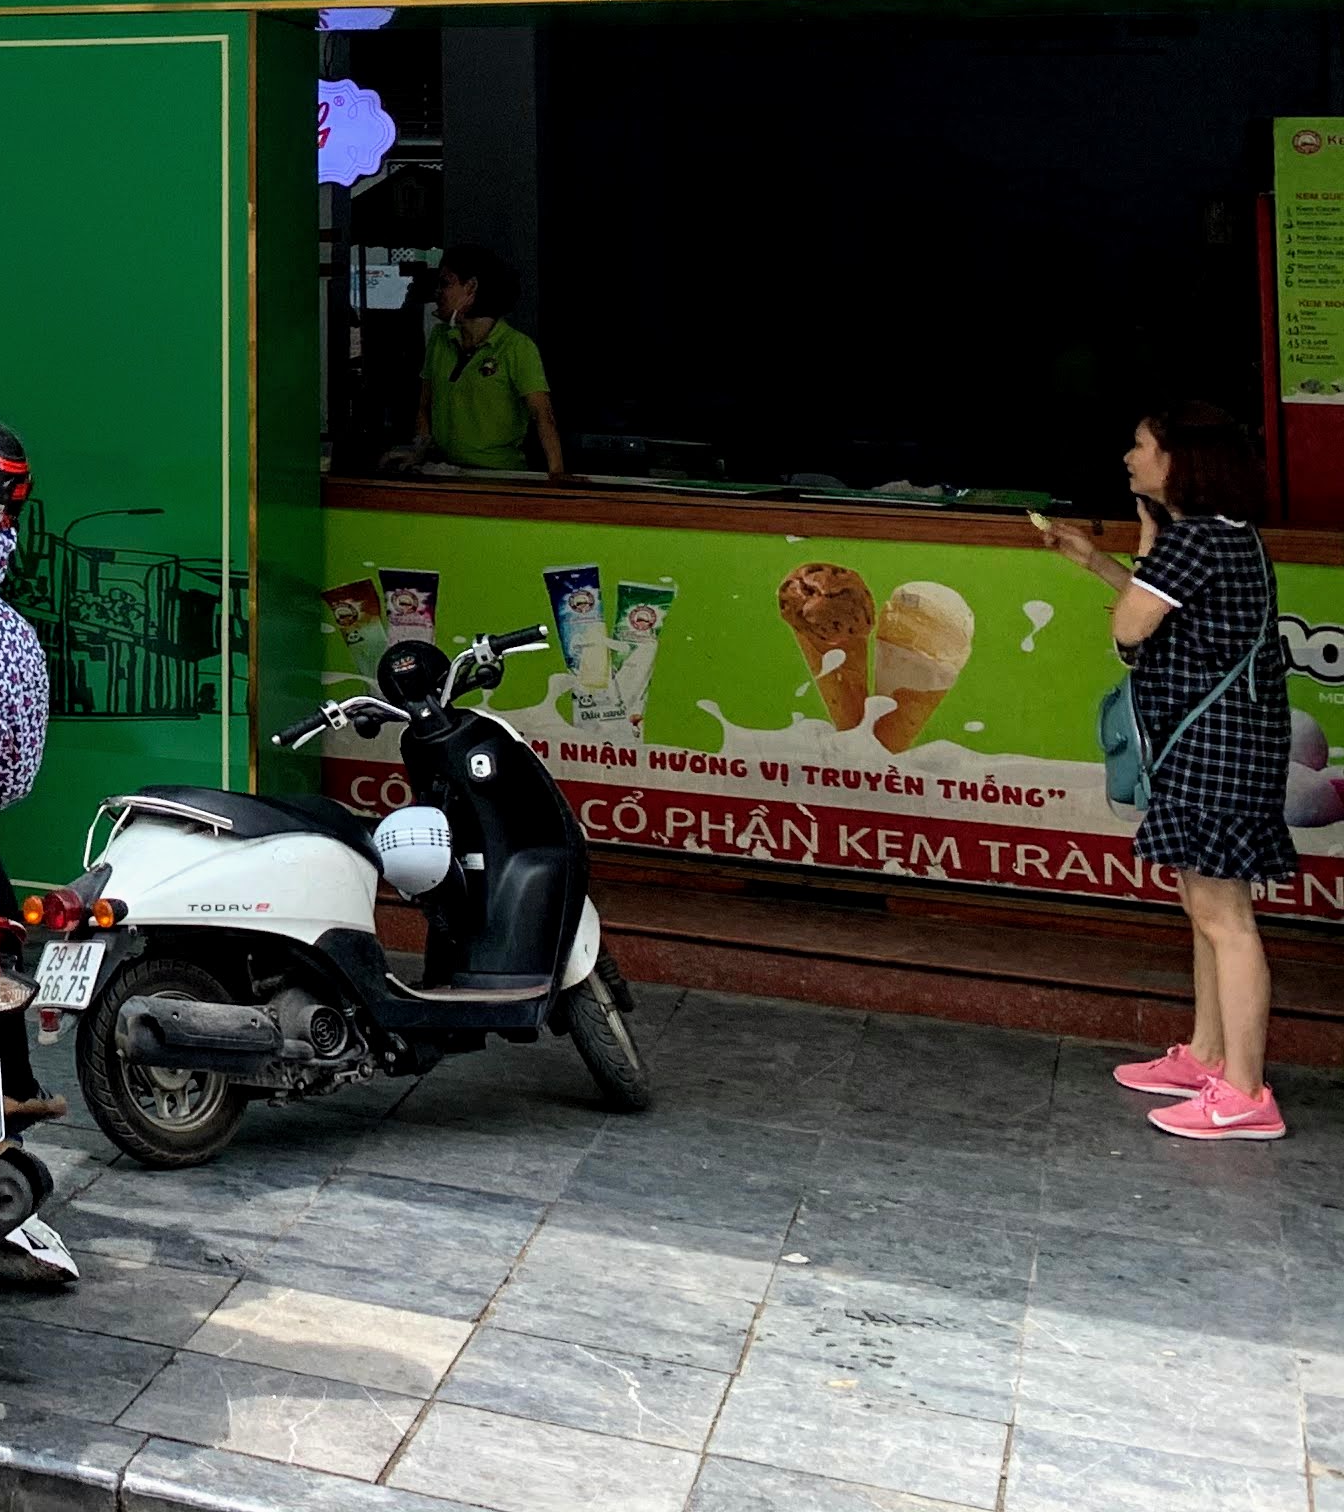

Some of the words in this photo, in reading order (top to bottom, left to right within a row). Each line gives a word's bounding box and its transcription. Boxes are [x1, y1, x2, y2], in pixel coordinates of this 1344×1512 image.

[560, 741, 637, 769] NHẬN
[649, 749, 747, 778] HƯƠNG
[759, 761, 789, 787] VỊ
[801, 765, 924, 796] TRUYỀN
[350, 768, 412, 807] CÔ
[581, 791, 648, 834] CỔ
[666, 804, 819, 855] PHẦN
[839, 825, 962, 870] KEM
[188, 904, 252, 912] TODAY
